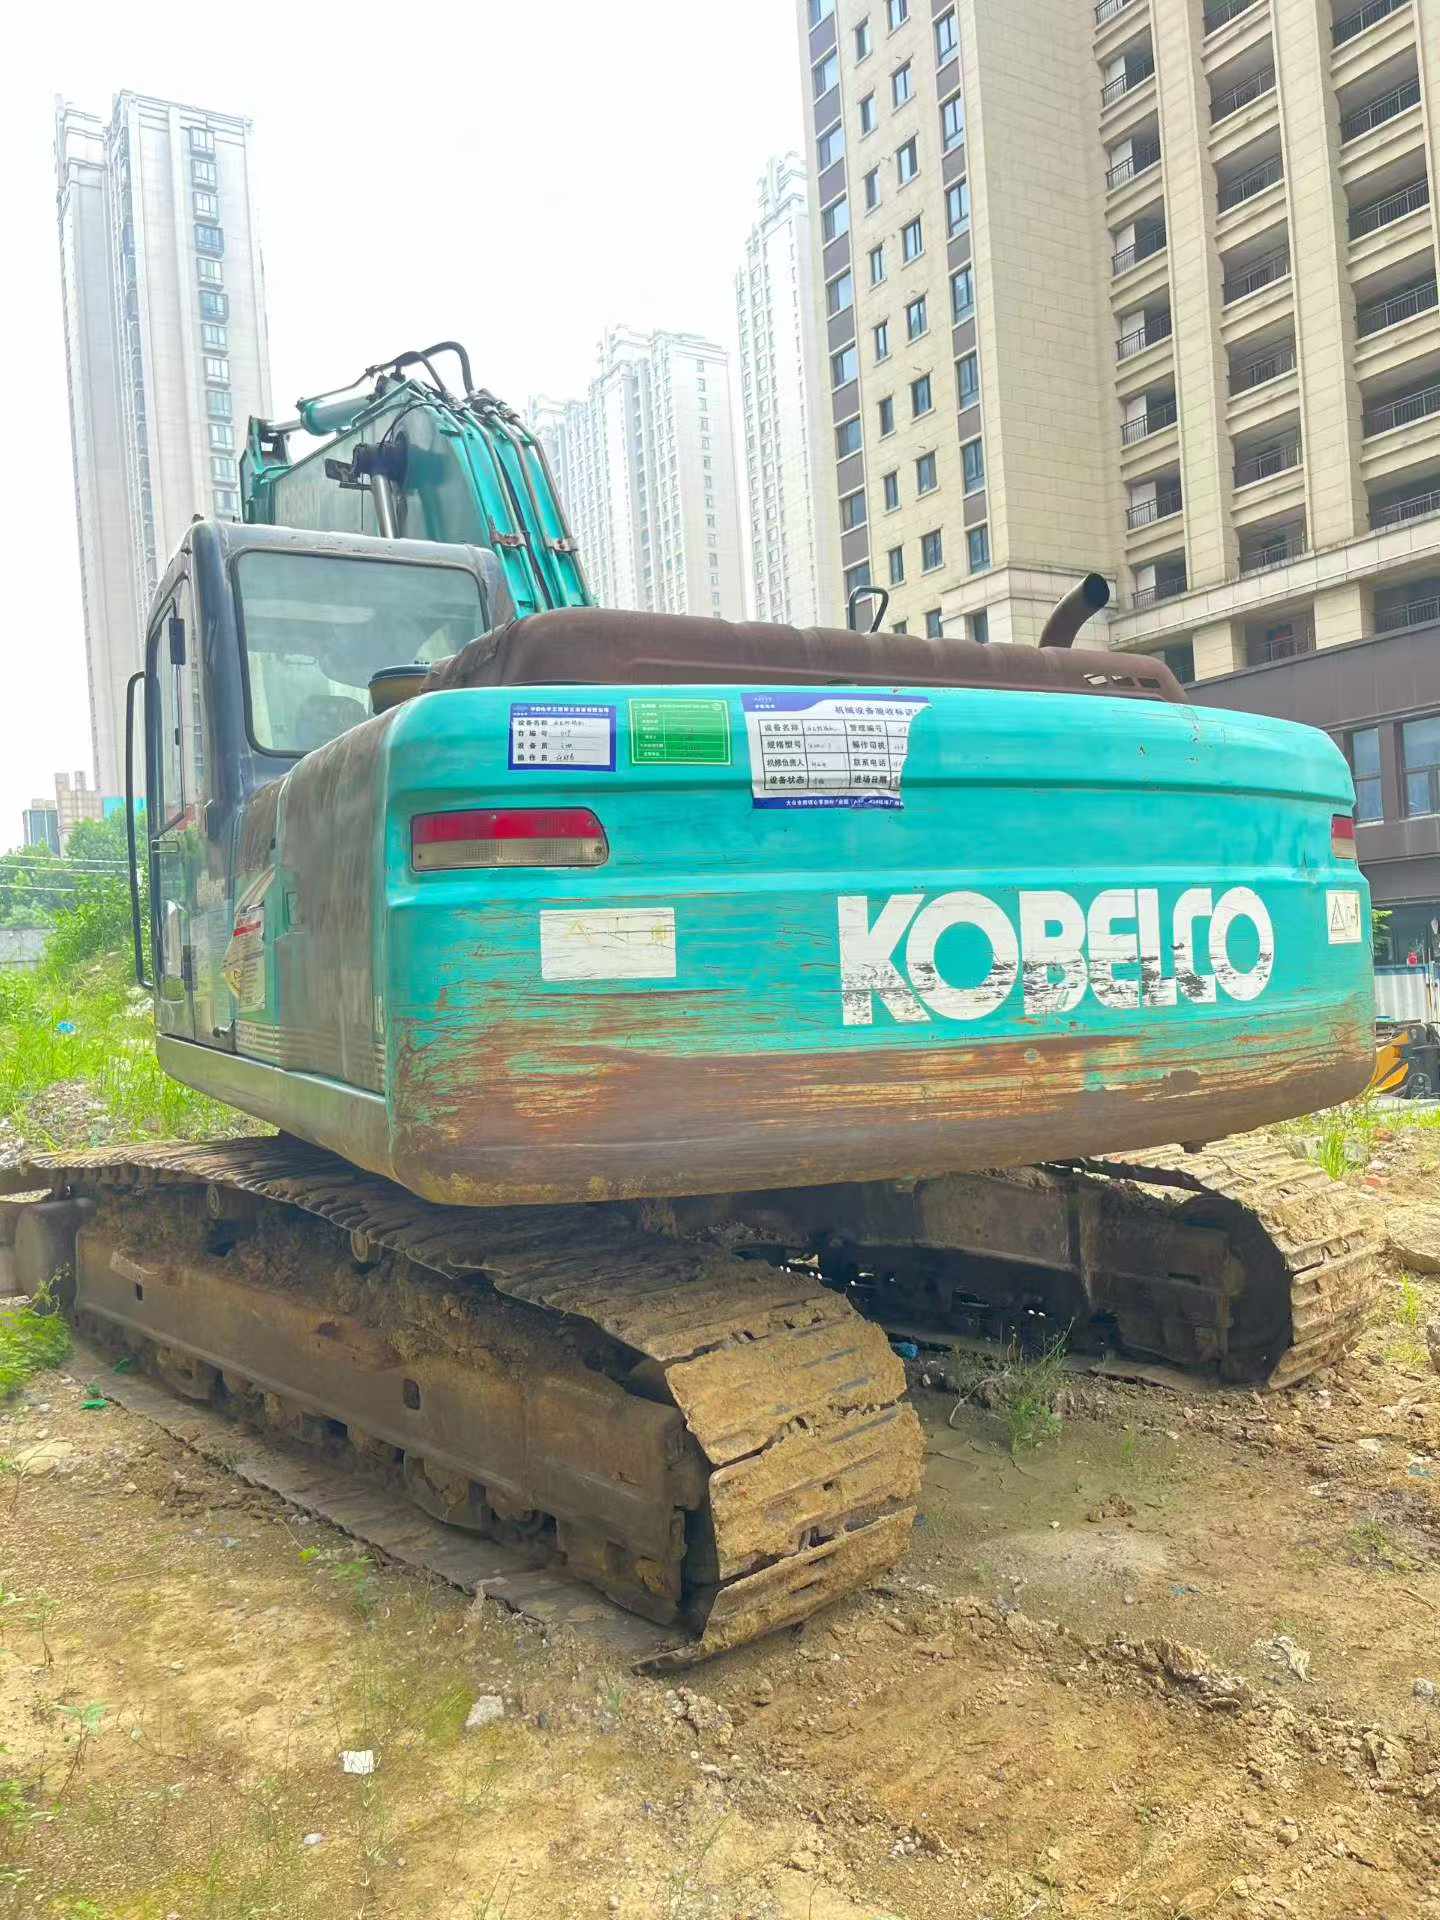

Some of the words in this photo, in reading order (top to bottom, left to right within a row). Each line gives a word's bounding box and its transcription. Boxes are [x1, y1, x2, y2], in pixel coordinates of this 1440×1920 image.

[853, 758, 887, 767] 联系电话
[769, 775, 805, 785] 设备状态
[853, 775, 887, 784] 进场日期
[837, 886, 1275, 1025] KOBELCO
